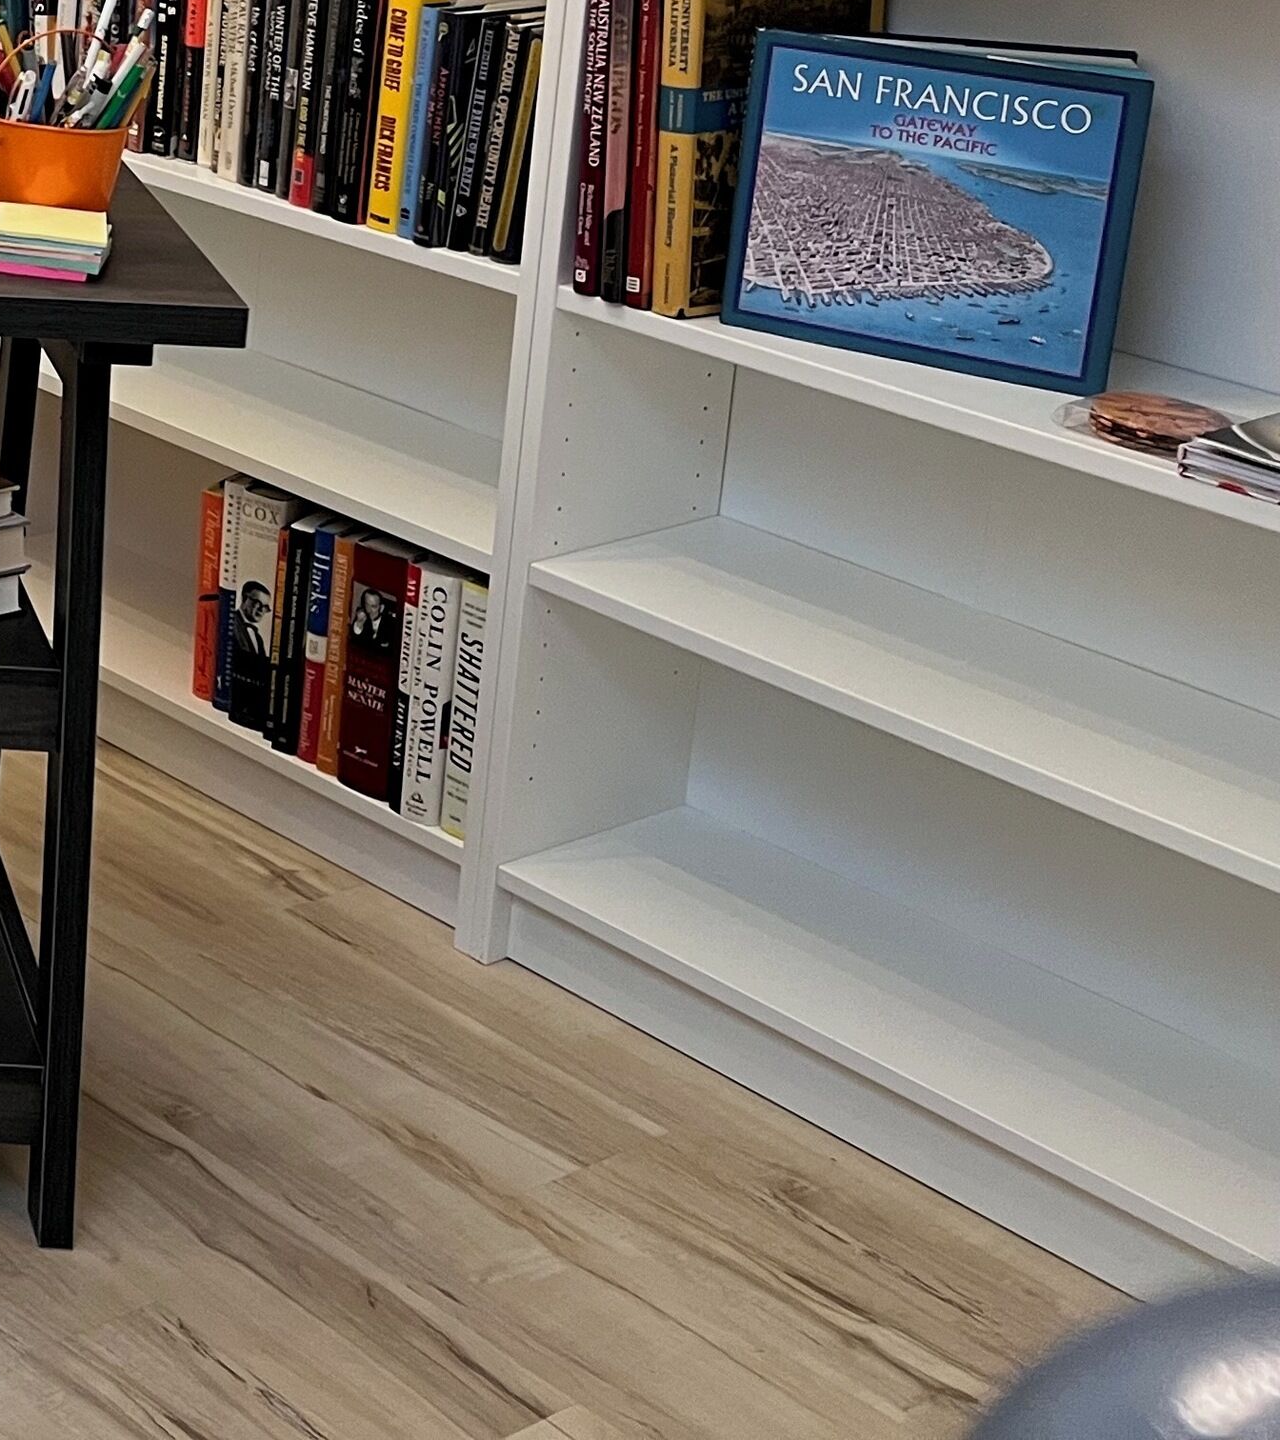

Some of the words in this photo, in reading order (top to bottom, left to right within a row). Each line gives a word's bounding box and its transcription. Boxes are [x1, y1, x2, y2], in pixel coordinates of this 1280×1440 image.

[391, 9, 407, 41] COME
[506, 32, 520, 51] AN
[301, 29, 316, 90] HAMILTON
[352, 38, 364, 55] of
[388, 44, 404, 57] TO
[384, 59, 403, 91] GRIEF
[500, 54, 515, 93] EQUAL
[592, 73, 605, 102] NEW
[792, 63, 863, 103] SAN
[874, 77, 1092, 135] FRANCISCO
[378, 116, 396, 141] DICK
[588, 106, 603, 167] ZEALAND
[869, 124, 891, 138] TO
[896, 127, 925, 145] THE
[931, 133, 997, 157] PACIFIC
[892, 113, 977, 138] GATEWAY
[373, 142, 395, 192] FRANCIS
[476, 184, 495, 228] DEATH
[425, 586, 448, 672] COLIN
[449, 632, 484, 774] SHATTERED
[414, 683, 438, 784] POWELL
